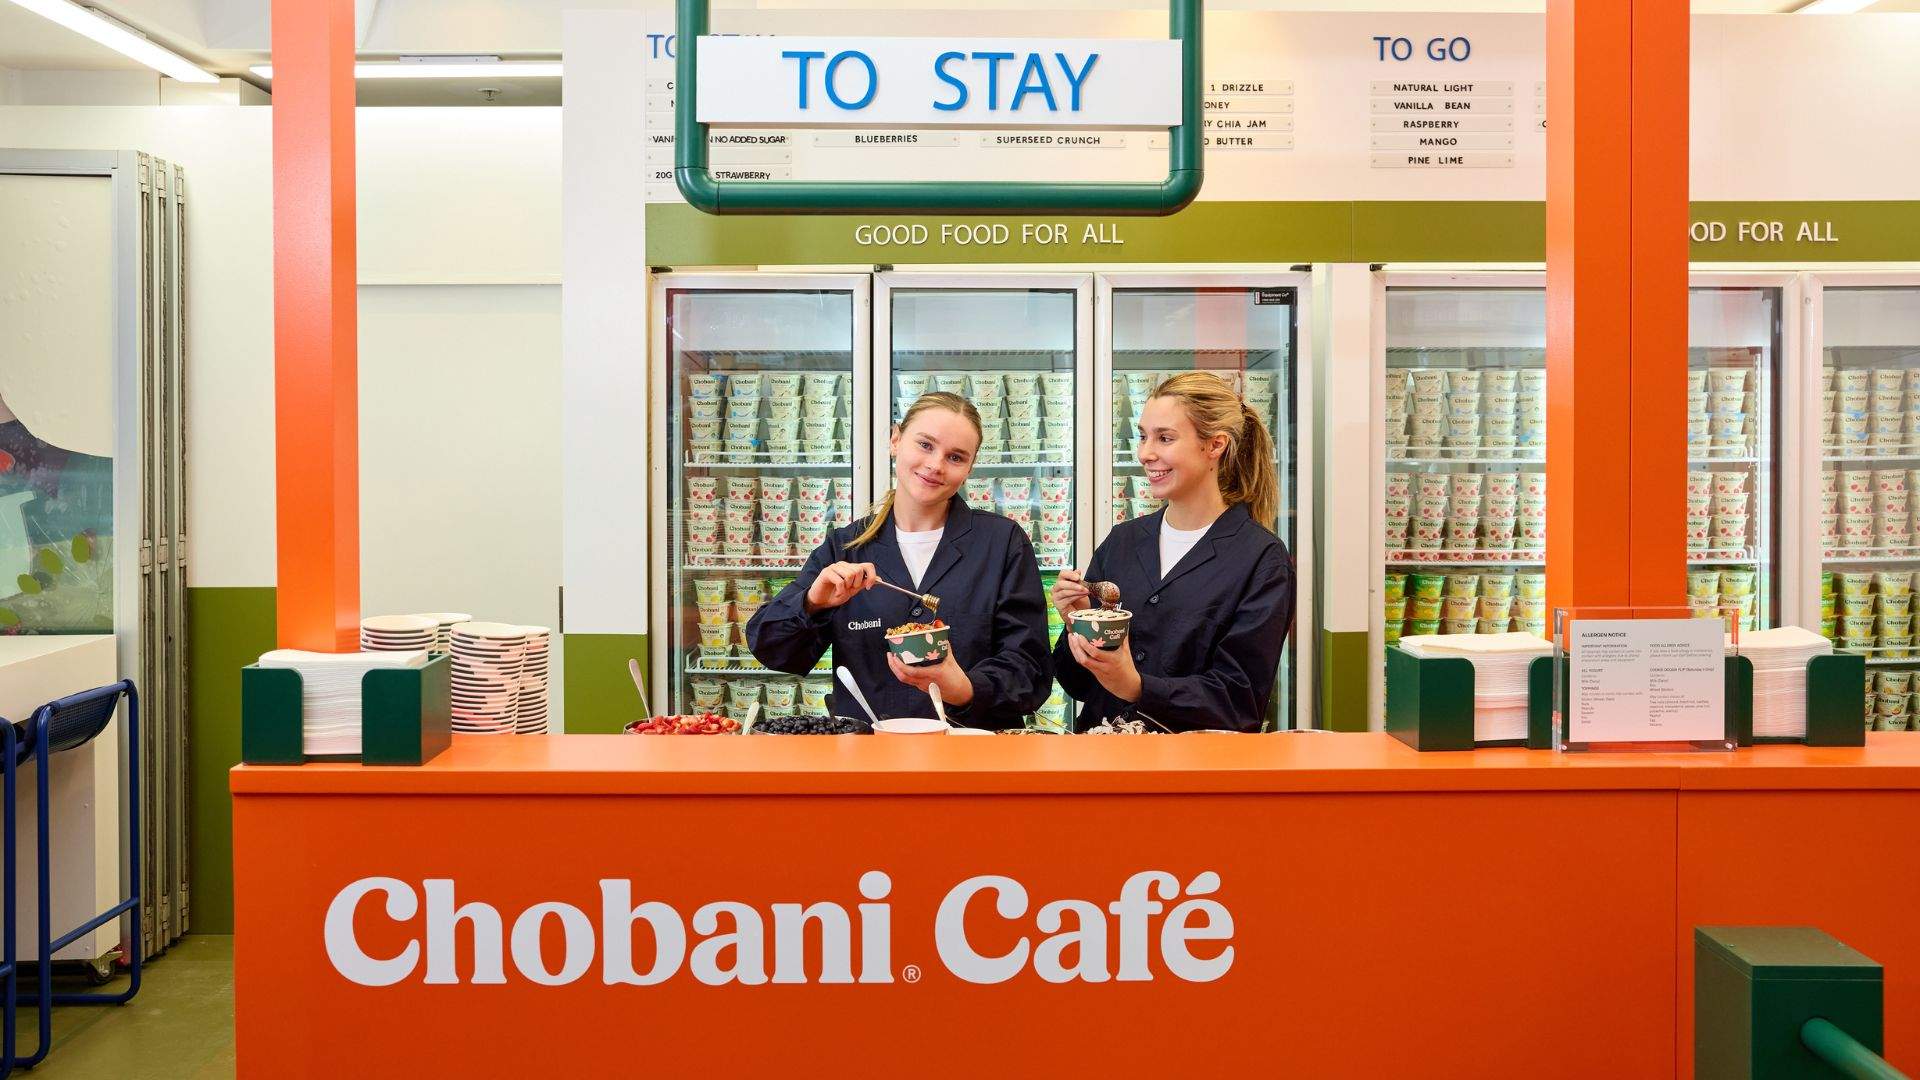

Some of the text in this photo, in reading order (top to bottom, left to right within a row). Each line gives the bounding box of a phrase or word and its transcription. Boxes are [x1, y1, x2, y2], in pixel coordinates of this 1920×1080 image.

[1373, 36, 1471, 62] TO GO
[782, 50, 1099, 111] TO STAY
[1221, 83, 1264, 92] DRIZZLE
[1392, 83, 1474, 92] NATURAL LIGHT
[1203, 101, 1231, 109] ONEY
[1393, 101, 1471, 110] VANILLA BEAN
[1216, 120, 1242, 128] CHIA
[1246, 120, 1267, 128] JAM
[1402, 120, 1460, 129] RASPBERRY
[714, 135, 729, 144] NO
[728, 135, 758, 144] ADDED
[758, 135, 786, 144] SUGAR
[854, 134, 918, 143] BLUEBERRIES
[996, 135, 1101, 145] SUPERSEED CRUNCH
[1216, 137, 1253, 146] BUTTER
[1418, 137, 1458, 146] MANGO
[1407, 156, 1464, 165] PINE LIME
[655, 171, 771, 180] 20G STRAWBERRY
[855, 223, 1124, 245] GOOD FOOD FOR ALL
[1689, 221, 1839, 242] OD FOR ALL
[847, 617, 882, 631] Chobani
[324, 870, 894, 986] Chobani
[934, 870, 1235, 985] Café
